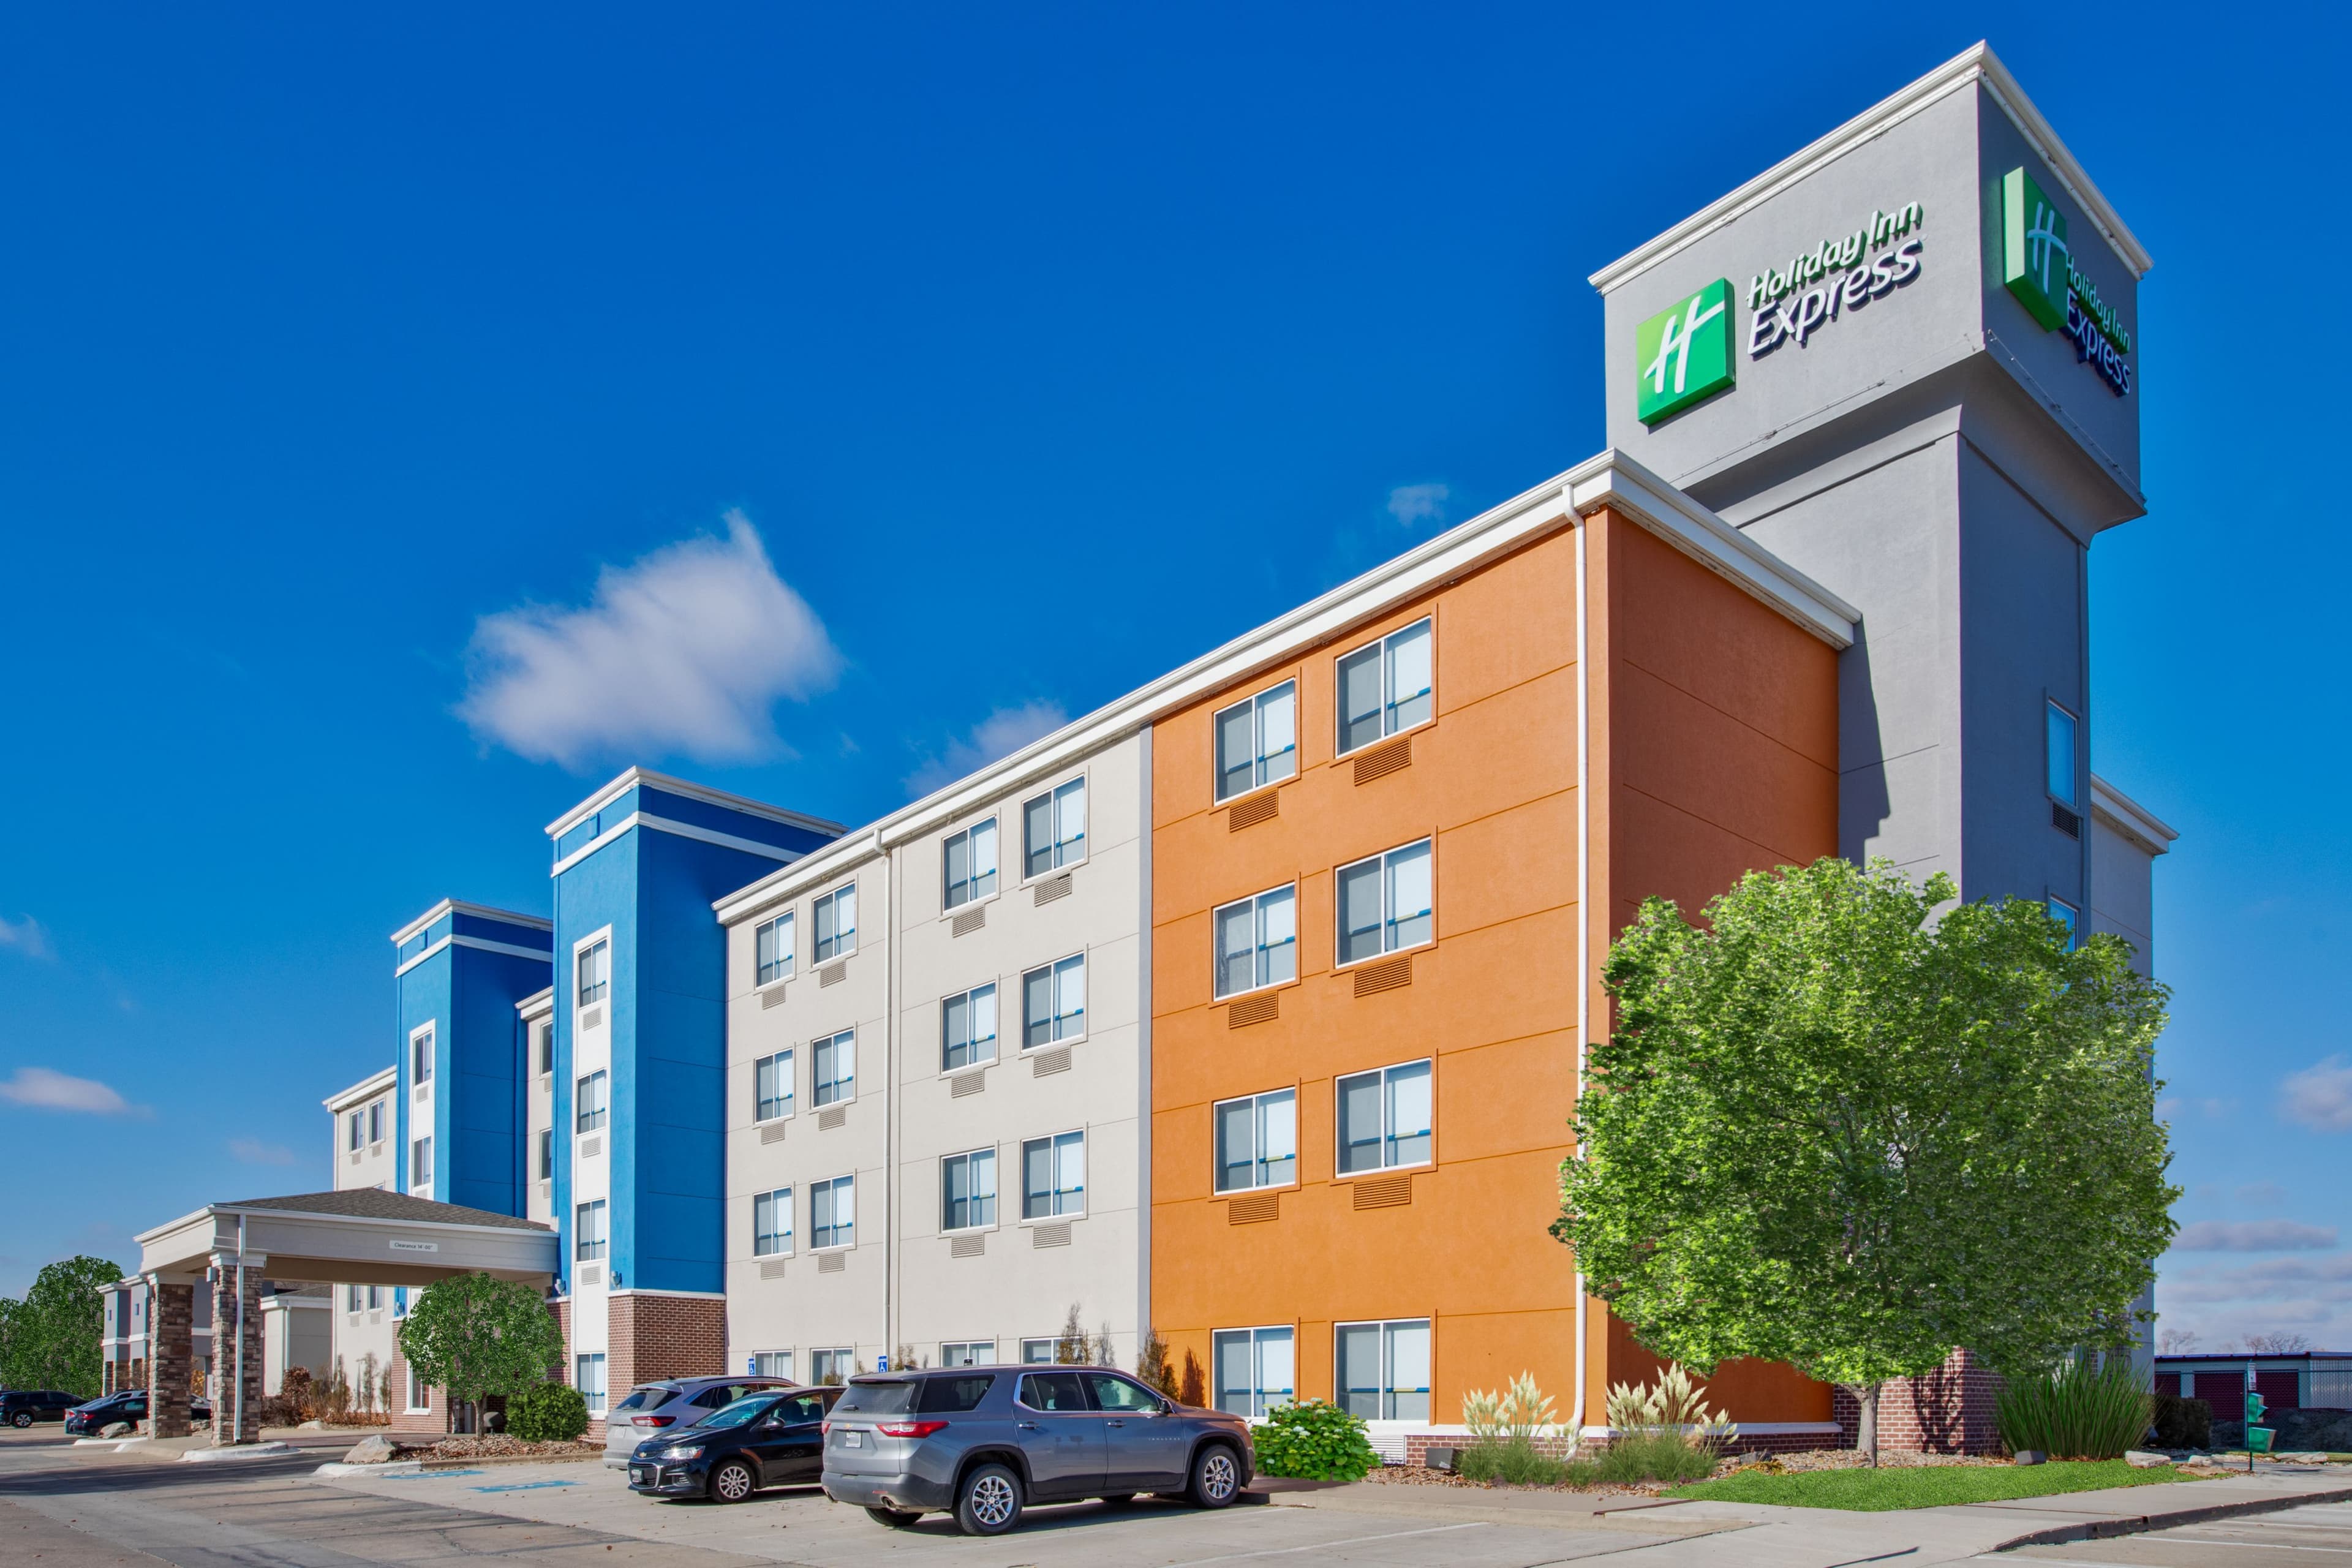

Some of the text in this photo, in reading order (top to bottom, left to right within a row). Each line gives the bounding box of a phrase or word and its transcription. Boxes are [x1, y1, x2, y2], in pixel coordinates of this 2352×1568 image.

[1746, 201, 1923, 309] Holiday Inn
[1747, 238, 1922, 354] Express
[2067, 251, 2130, 351] Holiday Inn
[1644, 295, 1725, 394] H
[2067, 287, 2130, 394] Express
